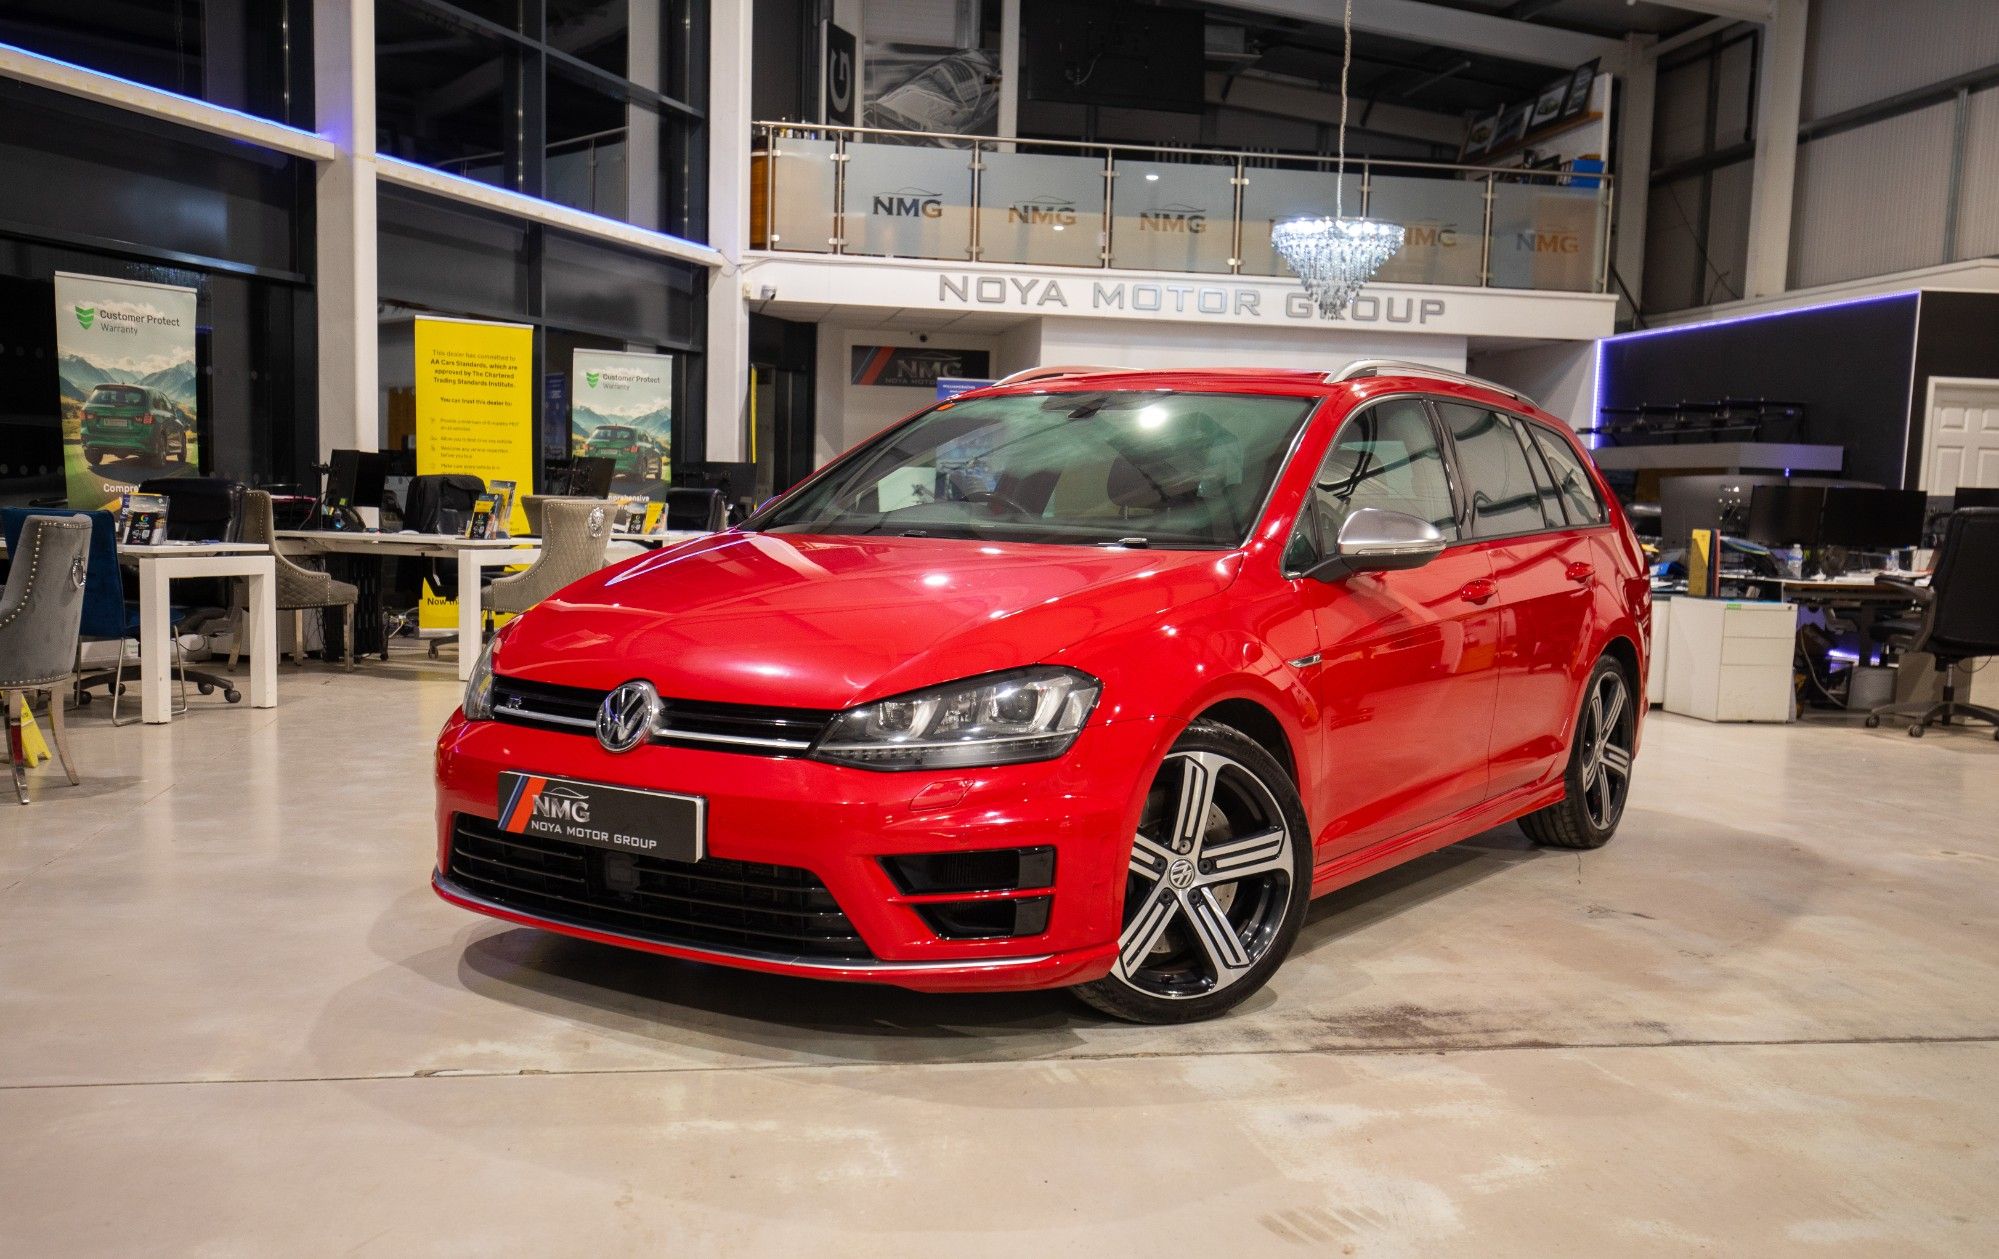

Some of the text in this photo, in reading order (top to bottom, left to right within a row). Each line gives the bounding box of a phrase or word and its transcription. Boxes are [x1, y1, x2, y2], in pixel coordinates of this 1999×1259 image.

[872, 195, 943, 219] NMG
[1008, 205, 1077, 225] NMG
[1139, 211, 1206, 234] NMG
[1516, 232, 1579, 253] NMG
[938, 273, 1068, 307] NOYA
[1093, 282, 1260, 317] MOTOR
[99, 309, 180, 327] Customer Protect
[100, 323, 138, 335] Warranty
[434, 368, 463, 376] approved
[484, 371, 515, 379] Chartered
[602, 372, 660, 384] Customer Protect
[897, 360, 962, 378] NMG
[433, 376, 456, 384] Trading
[457, 378, 487, 386] Standards
[103, 483, 141, 494] Compre
[427, 598, 447, 606] Now
[531, 794, 591, 823] NMG
[531, 820, 657, 849] NOYA MOTOR GROUP
